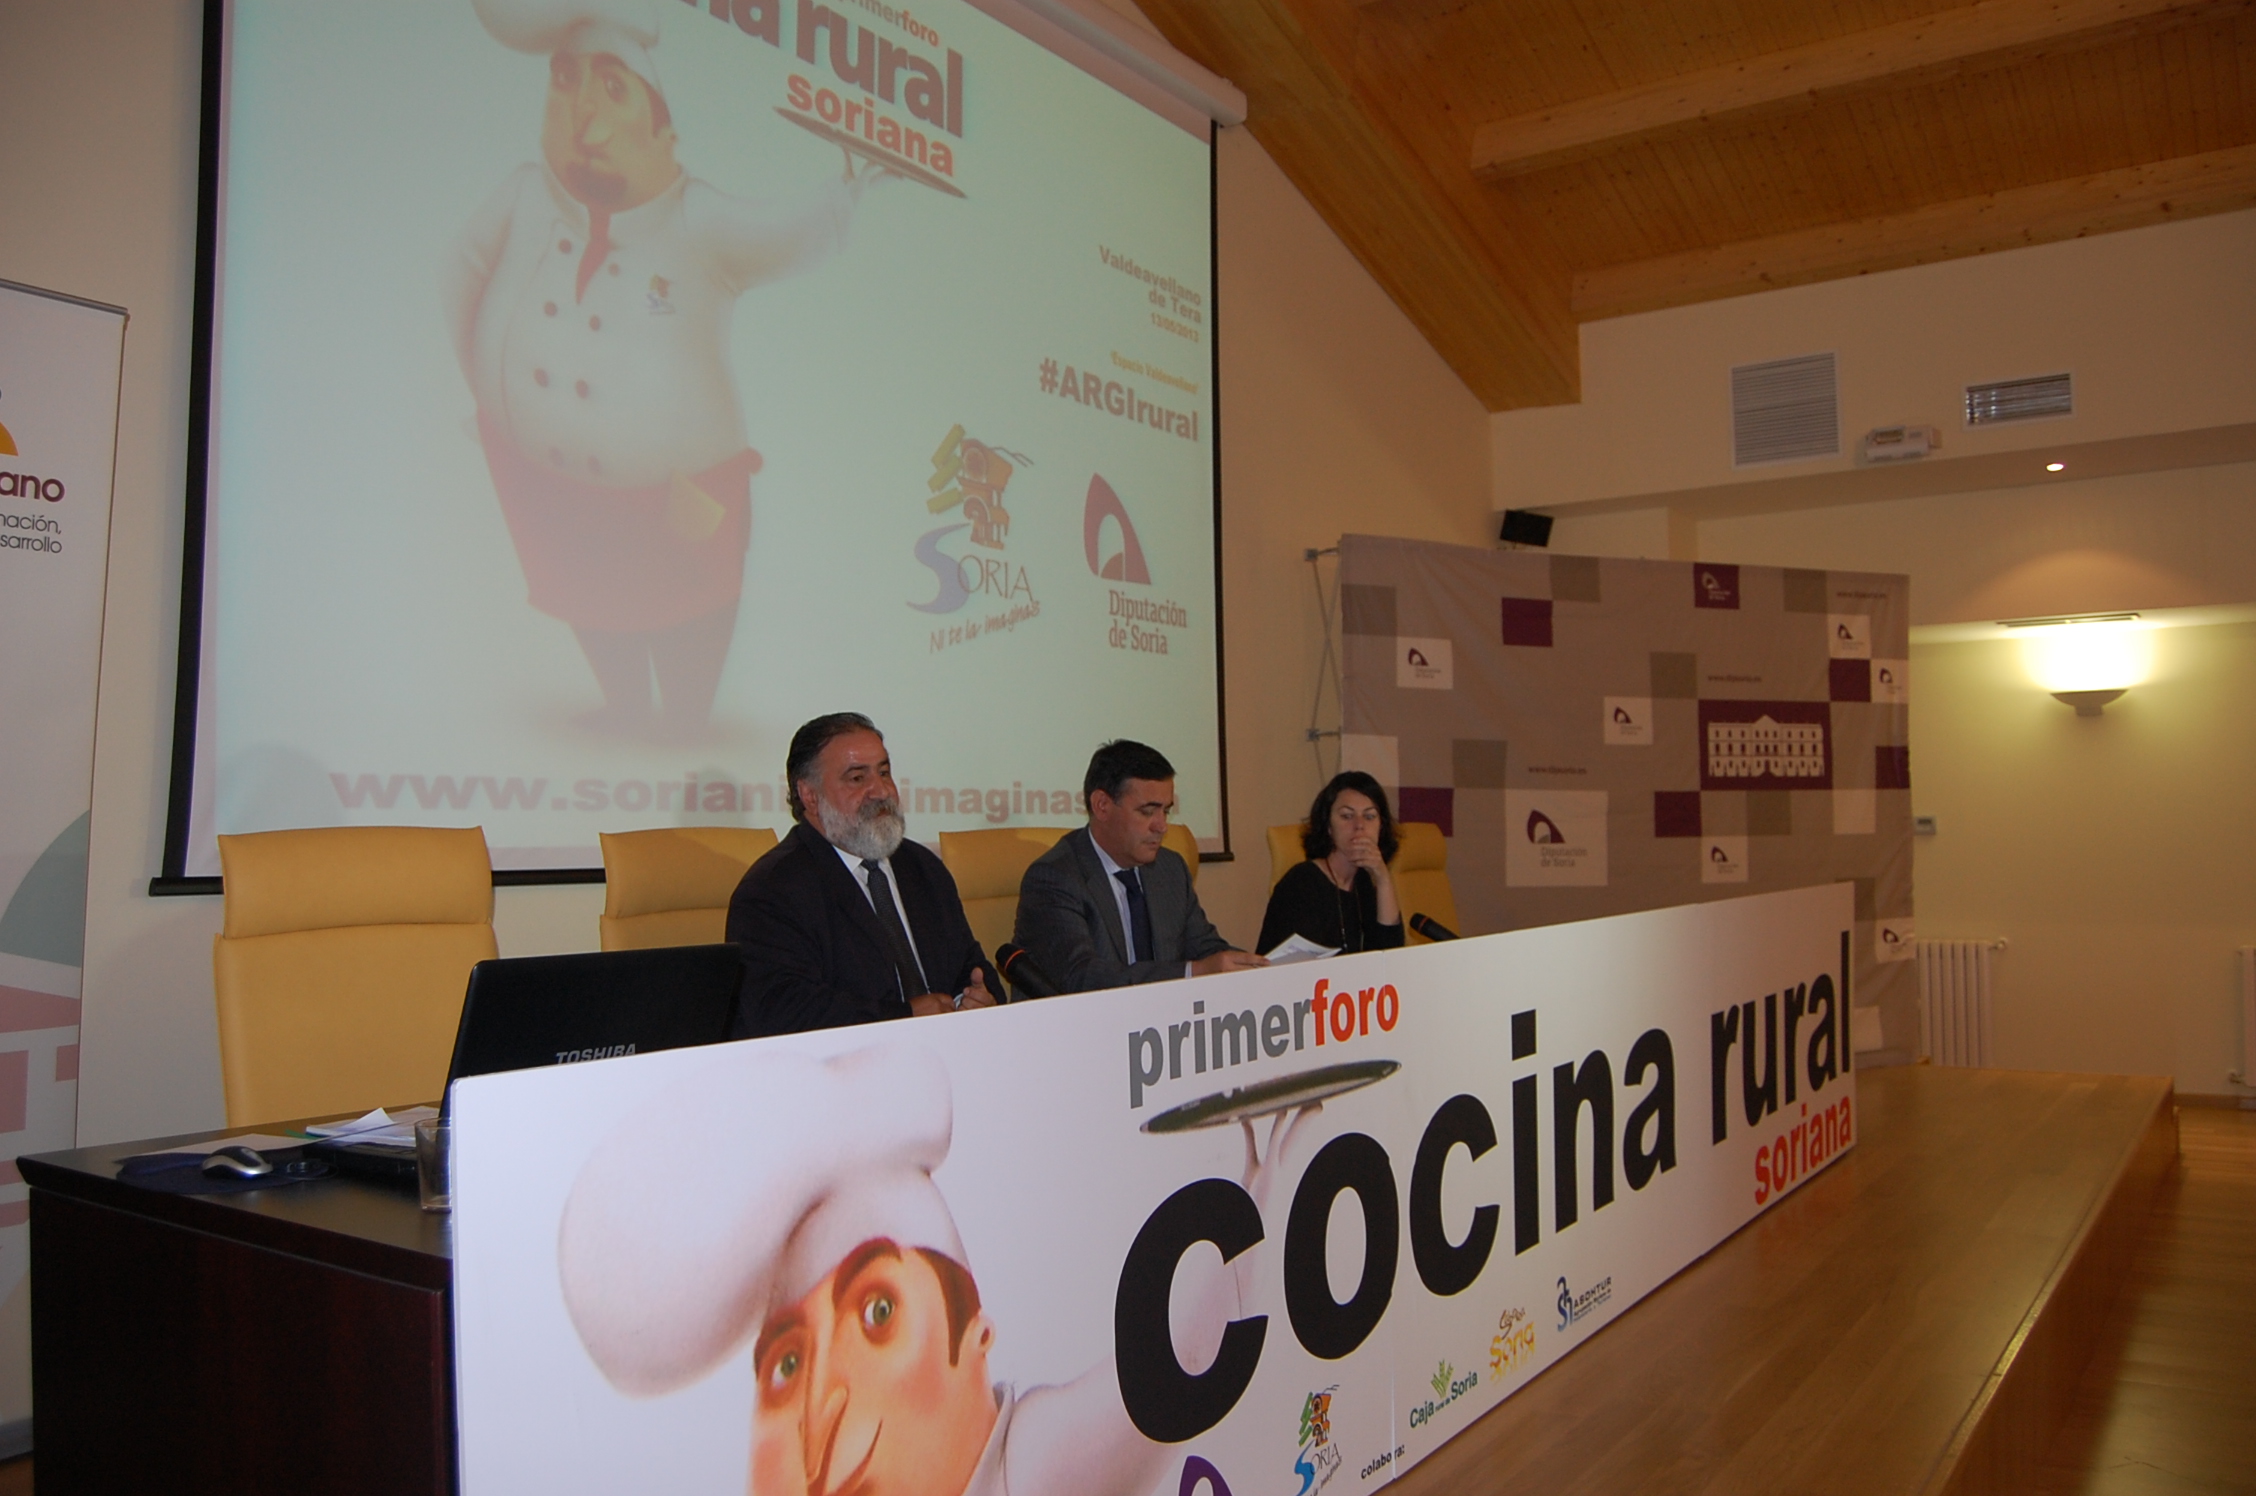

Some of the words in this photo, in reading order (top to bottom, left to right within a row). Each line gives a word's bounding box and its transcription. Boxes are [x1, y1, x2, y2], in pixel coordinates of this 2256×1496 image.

[796, 0, 963, 138] rural
[787, 74, 953, 177] soriana
[1099, 245, 1202, 306] Valdeavellano
[1149, 289, 1166, 308] de
[1170, 295, 1202, 324] Tera
[1039, 357, 1198, 442] #ARGIrural
[1108, 623, 1127, 649] de
[1131, 624, 1168, 654] Soria
[1109, 589, 1187, 628] Diputación
[556, 1043, 636, 1064] TOSHIBA
[1755, 1095, 1851, 1205] soriana
[1114, 1008, 1678, 1443] cocina
[1711, 930, 1851, 1146] rural
[1410, 1400, 1434, 1429] Caja
[1451, 1371, 1478, 1401] Soria
